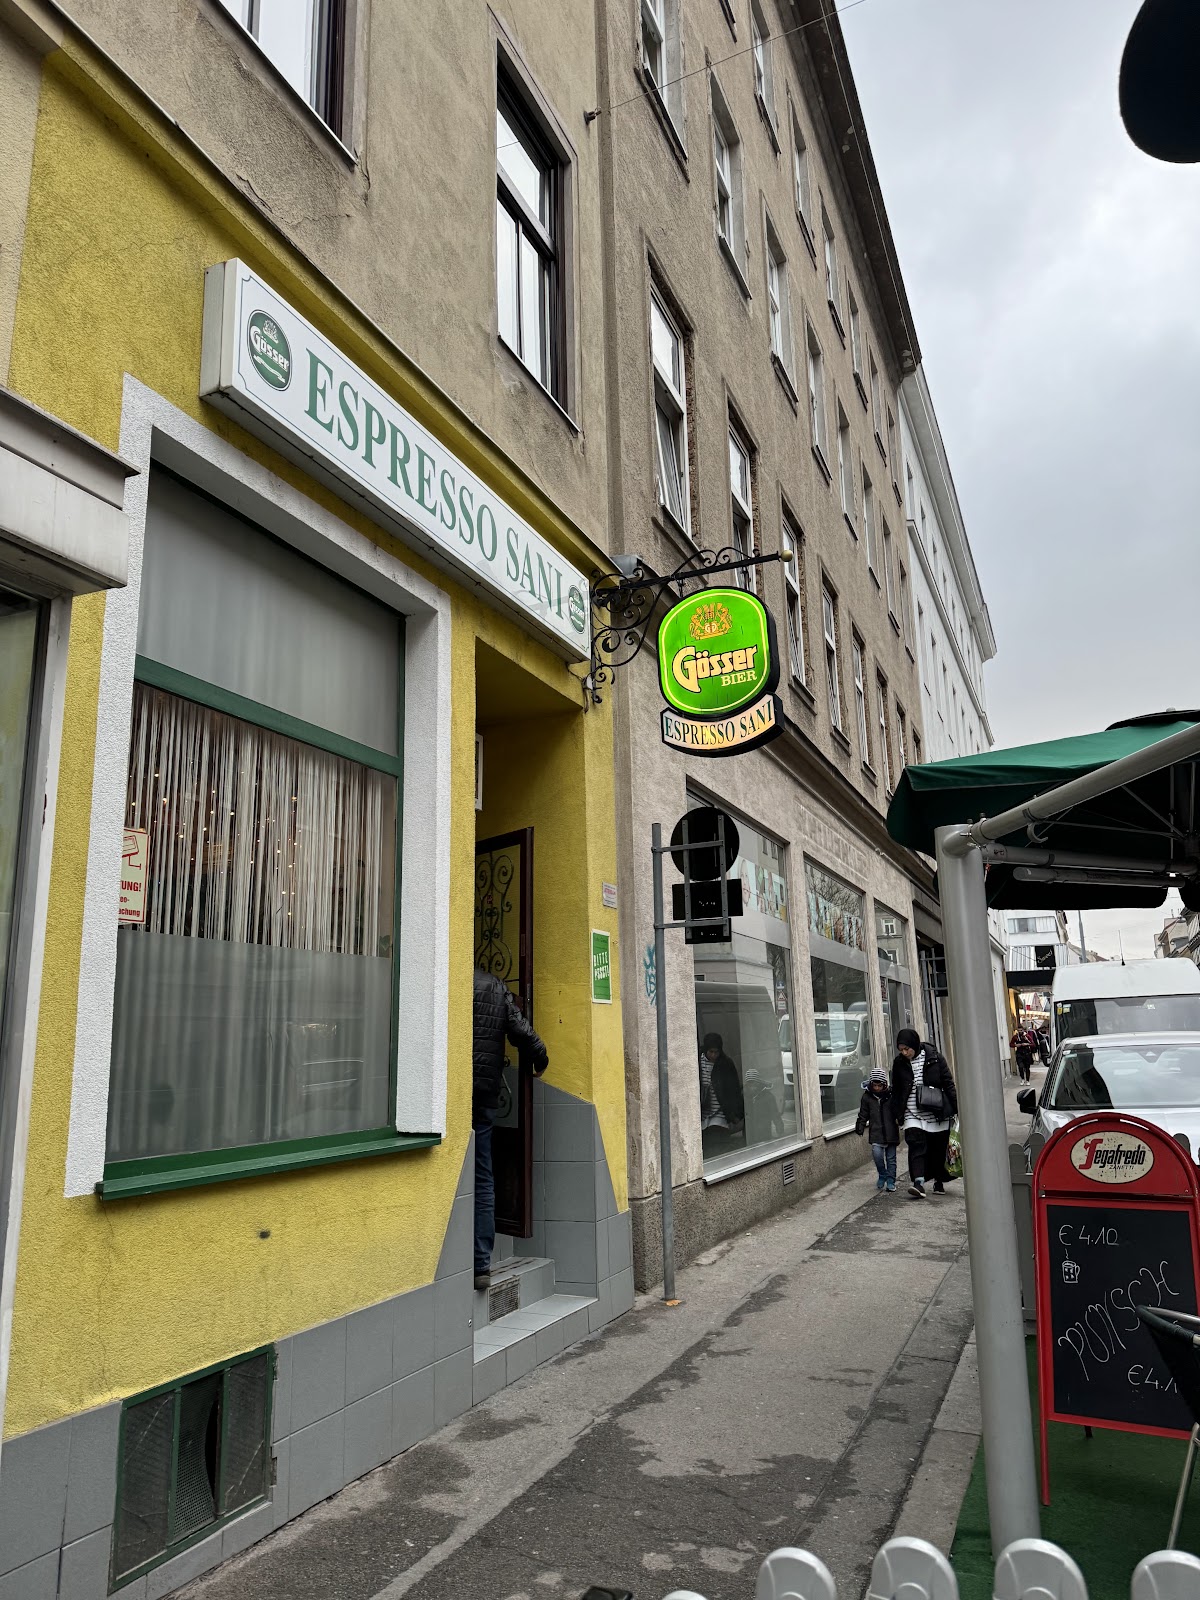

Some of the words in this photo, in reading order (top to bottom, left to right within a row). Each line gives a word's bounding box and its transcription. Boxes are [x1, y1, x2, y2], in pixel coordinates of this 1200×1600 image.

[250, 326, 289, 372] Gösser
[304, 348, 498, 562] ESPRESSO
[506, 527, 564, 620] SANI
[672, 644, 758, 693] Gösser
[721, 670, 758, 687] BIER
[664, 715, 735, 746] ESPRESSO
[740, 700, 773, 738] SANI
[121, 880, 142, 892] UNG!
[1078, 1138, 1146, 1170] Segafredo
